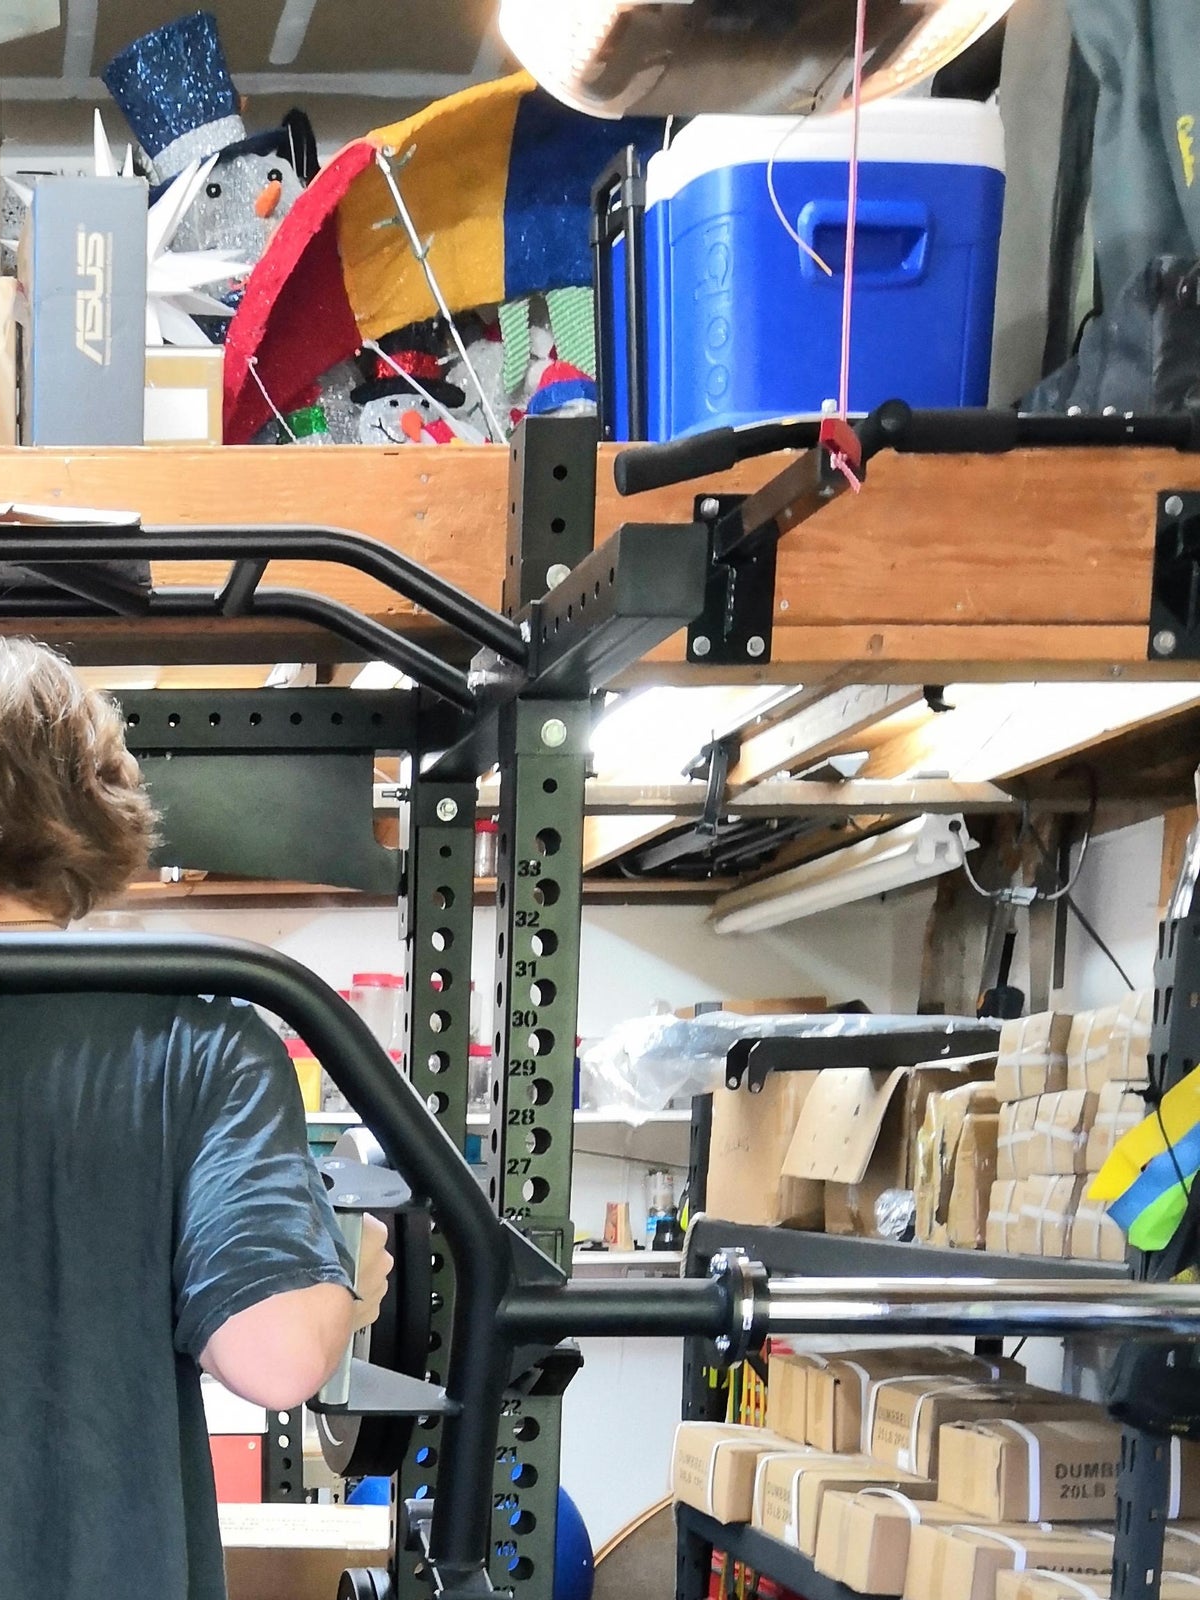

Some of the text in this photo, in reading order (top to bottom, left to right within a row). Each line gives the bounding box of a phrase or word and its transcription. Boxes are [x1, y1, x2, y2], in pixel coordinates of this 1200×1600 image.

[75, 231, 107, 365] ASUS
[517, 859, 542, 877] 33
[515, 910, 540, 928] 32
[515, 961, 537, 978] 31
[511, 1009, 538, 1028] 30
[509, 1059, 537, 1077] 29
[508, 1108, 535, 1126] 28
[506, 1158, 532, 1176] 27
[1055, 1463, 1120, 1480] DUMB
